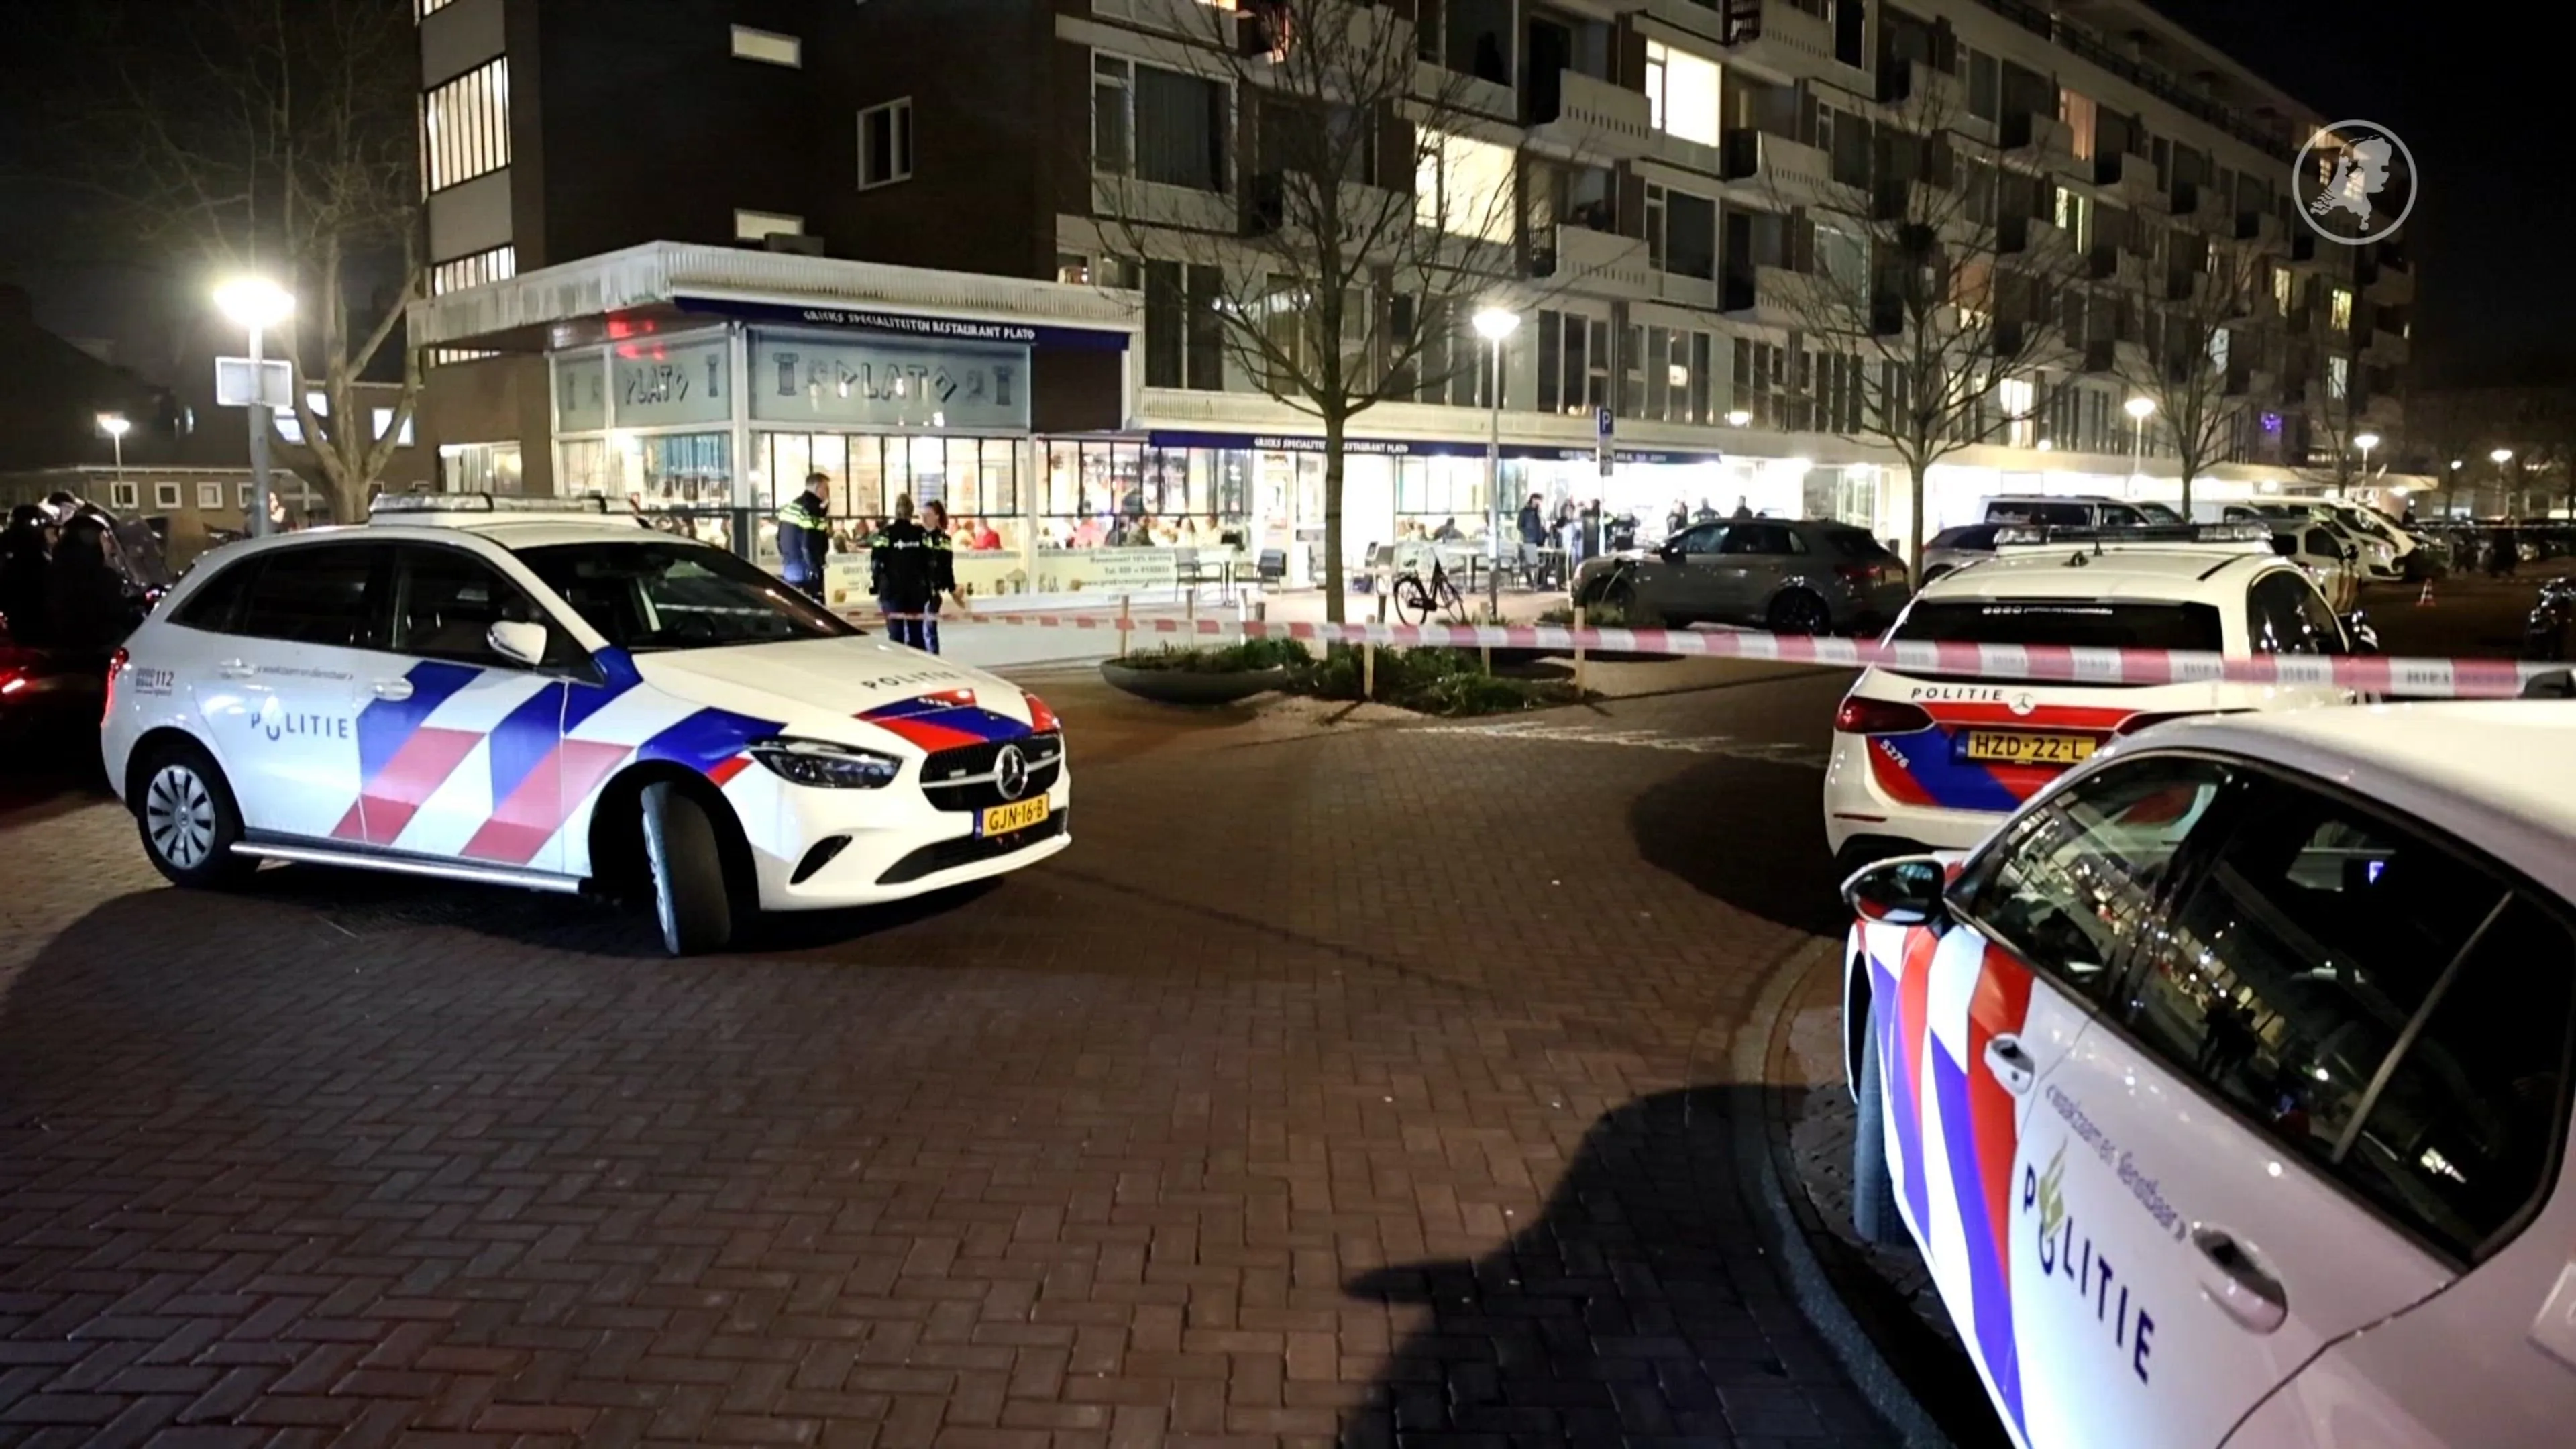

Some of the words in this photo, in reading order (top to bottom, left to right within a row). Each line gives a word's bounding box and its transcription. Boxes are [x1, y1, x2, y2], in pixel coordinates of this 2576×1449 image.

[849, 313, 930, 332] SPECIALITEITEN
[932, 321, 1000, 339] RESTAURANT
[1003, 327, 1036, 340] PLATO
[835, 359, 958, 403] PLATO
[1601, 411, 1611, 431] P
[156, 670, 174, 686] 112
[861, 671, 961, 691] POLITIE
[1911, 687, 2004, 701] POLITIE
[251, 711, 348, 741] POLITIE
[1879, 738, 1910, 769] 5276
[1975, 735, 2084, 761] HZD-22-L
[989, 798, 1044, 831] GJN-16-B
[2023, 1161, 2155, 1386] POLITIE
